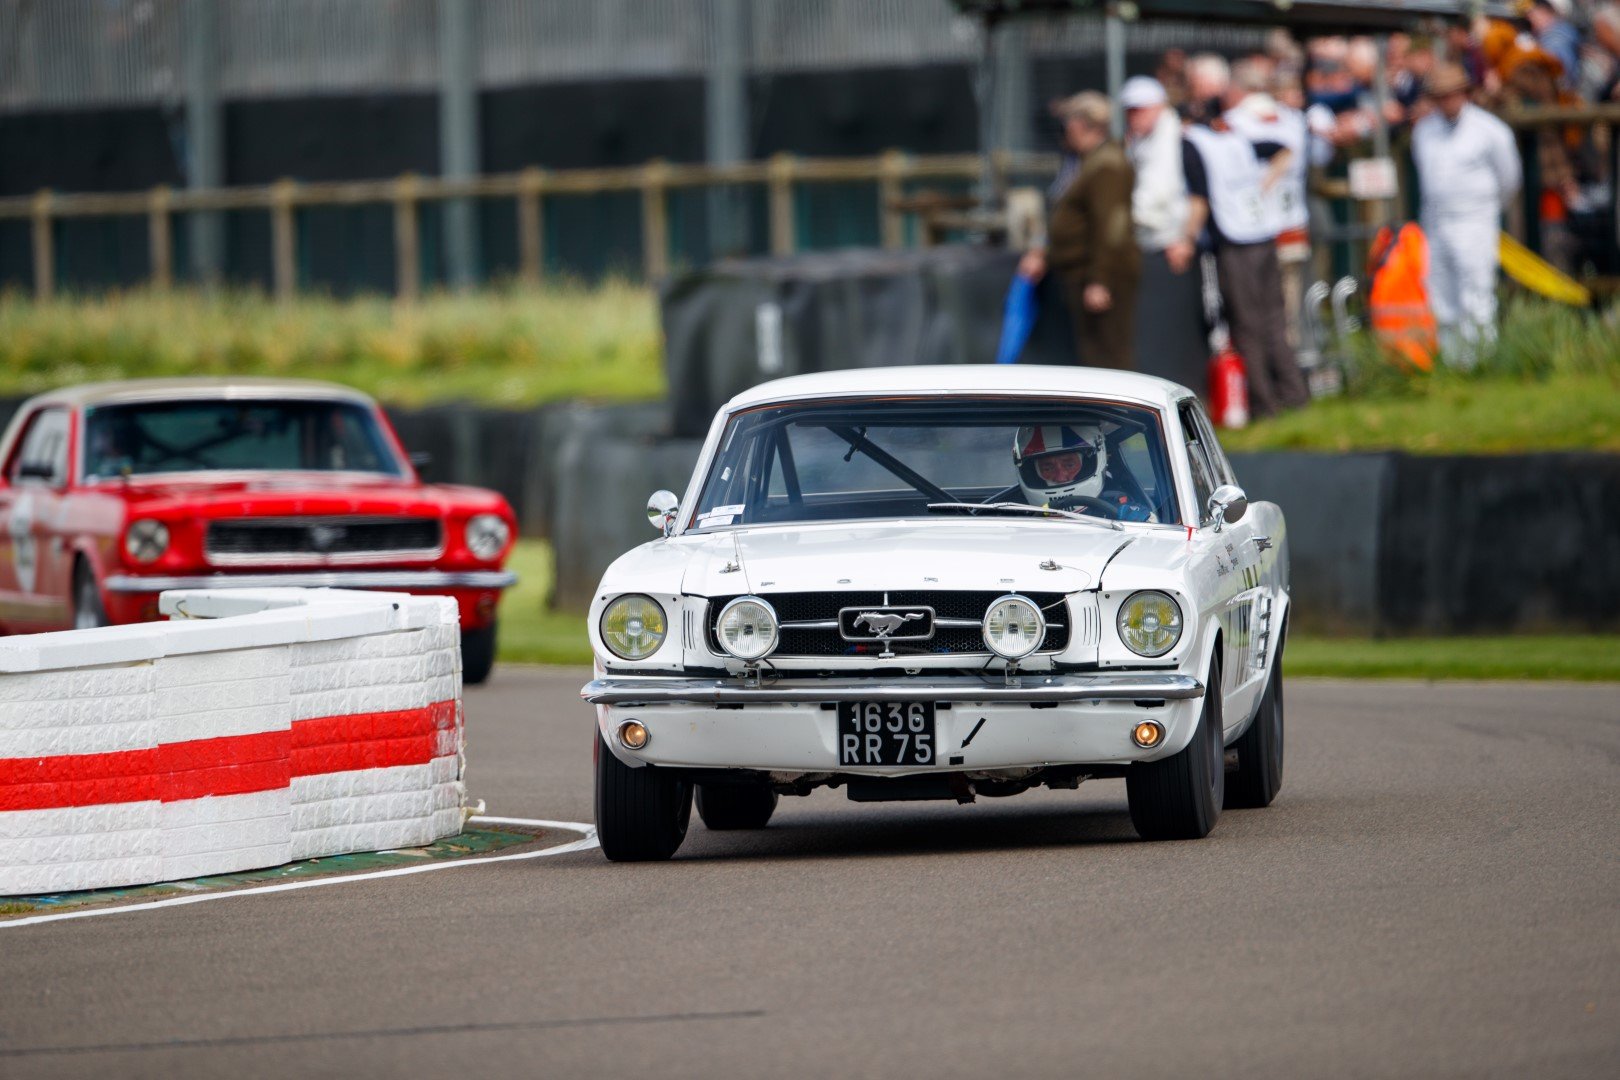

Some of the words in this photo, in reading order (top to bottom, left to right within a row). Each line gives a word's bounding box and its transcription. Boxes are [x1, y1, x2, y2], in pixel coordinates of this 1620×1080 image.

[851, 702, 925, 733] 1636
[843, 733, 883, 764] RR
[892, 733, 932, 764] 75
